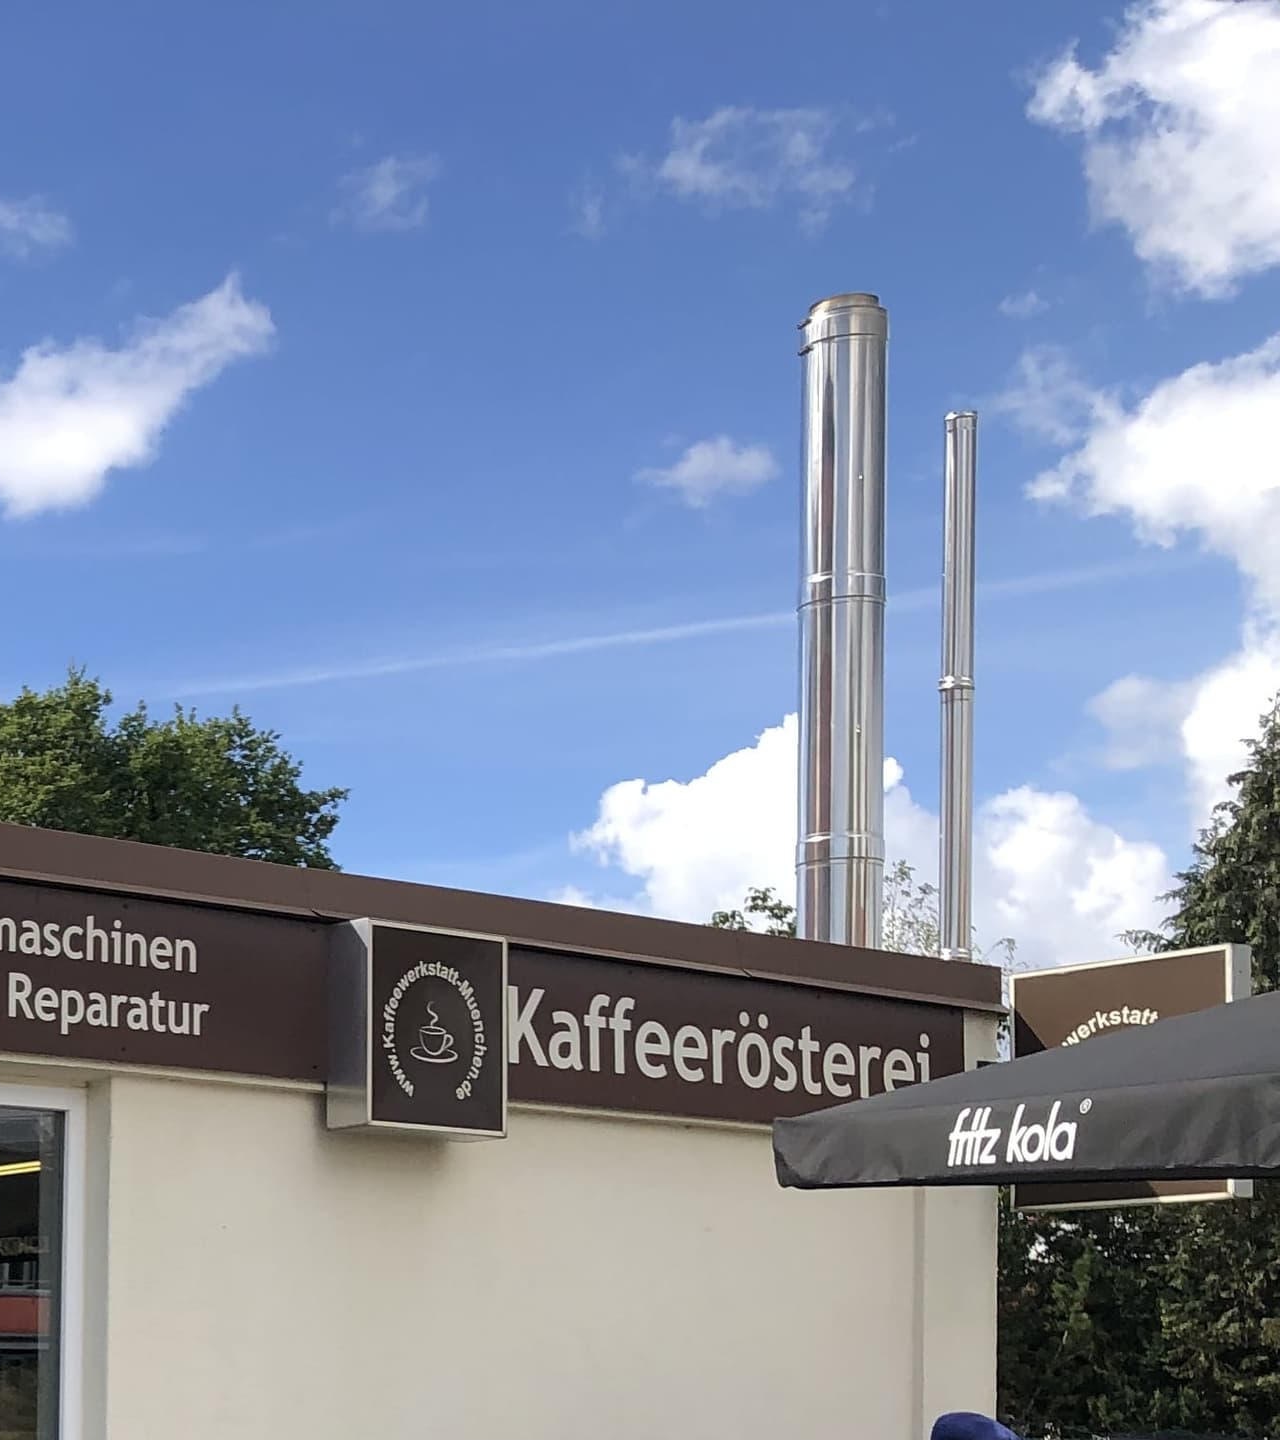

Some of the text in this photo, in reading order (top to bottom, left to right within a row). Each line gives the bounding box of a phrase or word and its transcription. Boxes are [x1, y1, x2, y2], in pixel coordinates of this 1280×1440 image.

[8, 972, 210, 1037] Reparatur
[506, 985, 931, 1099] Kaffeerösterei
[948, 1106, 1001, 1167] fritz
